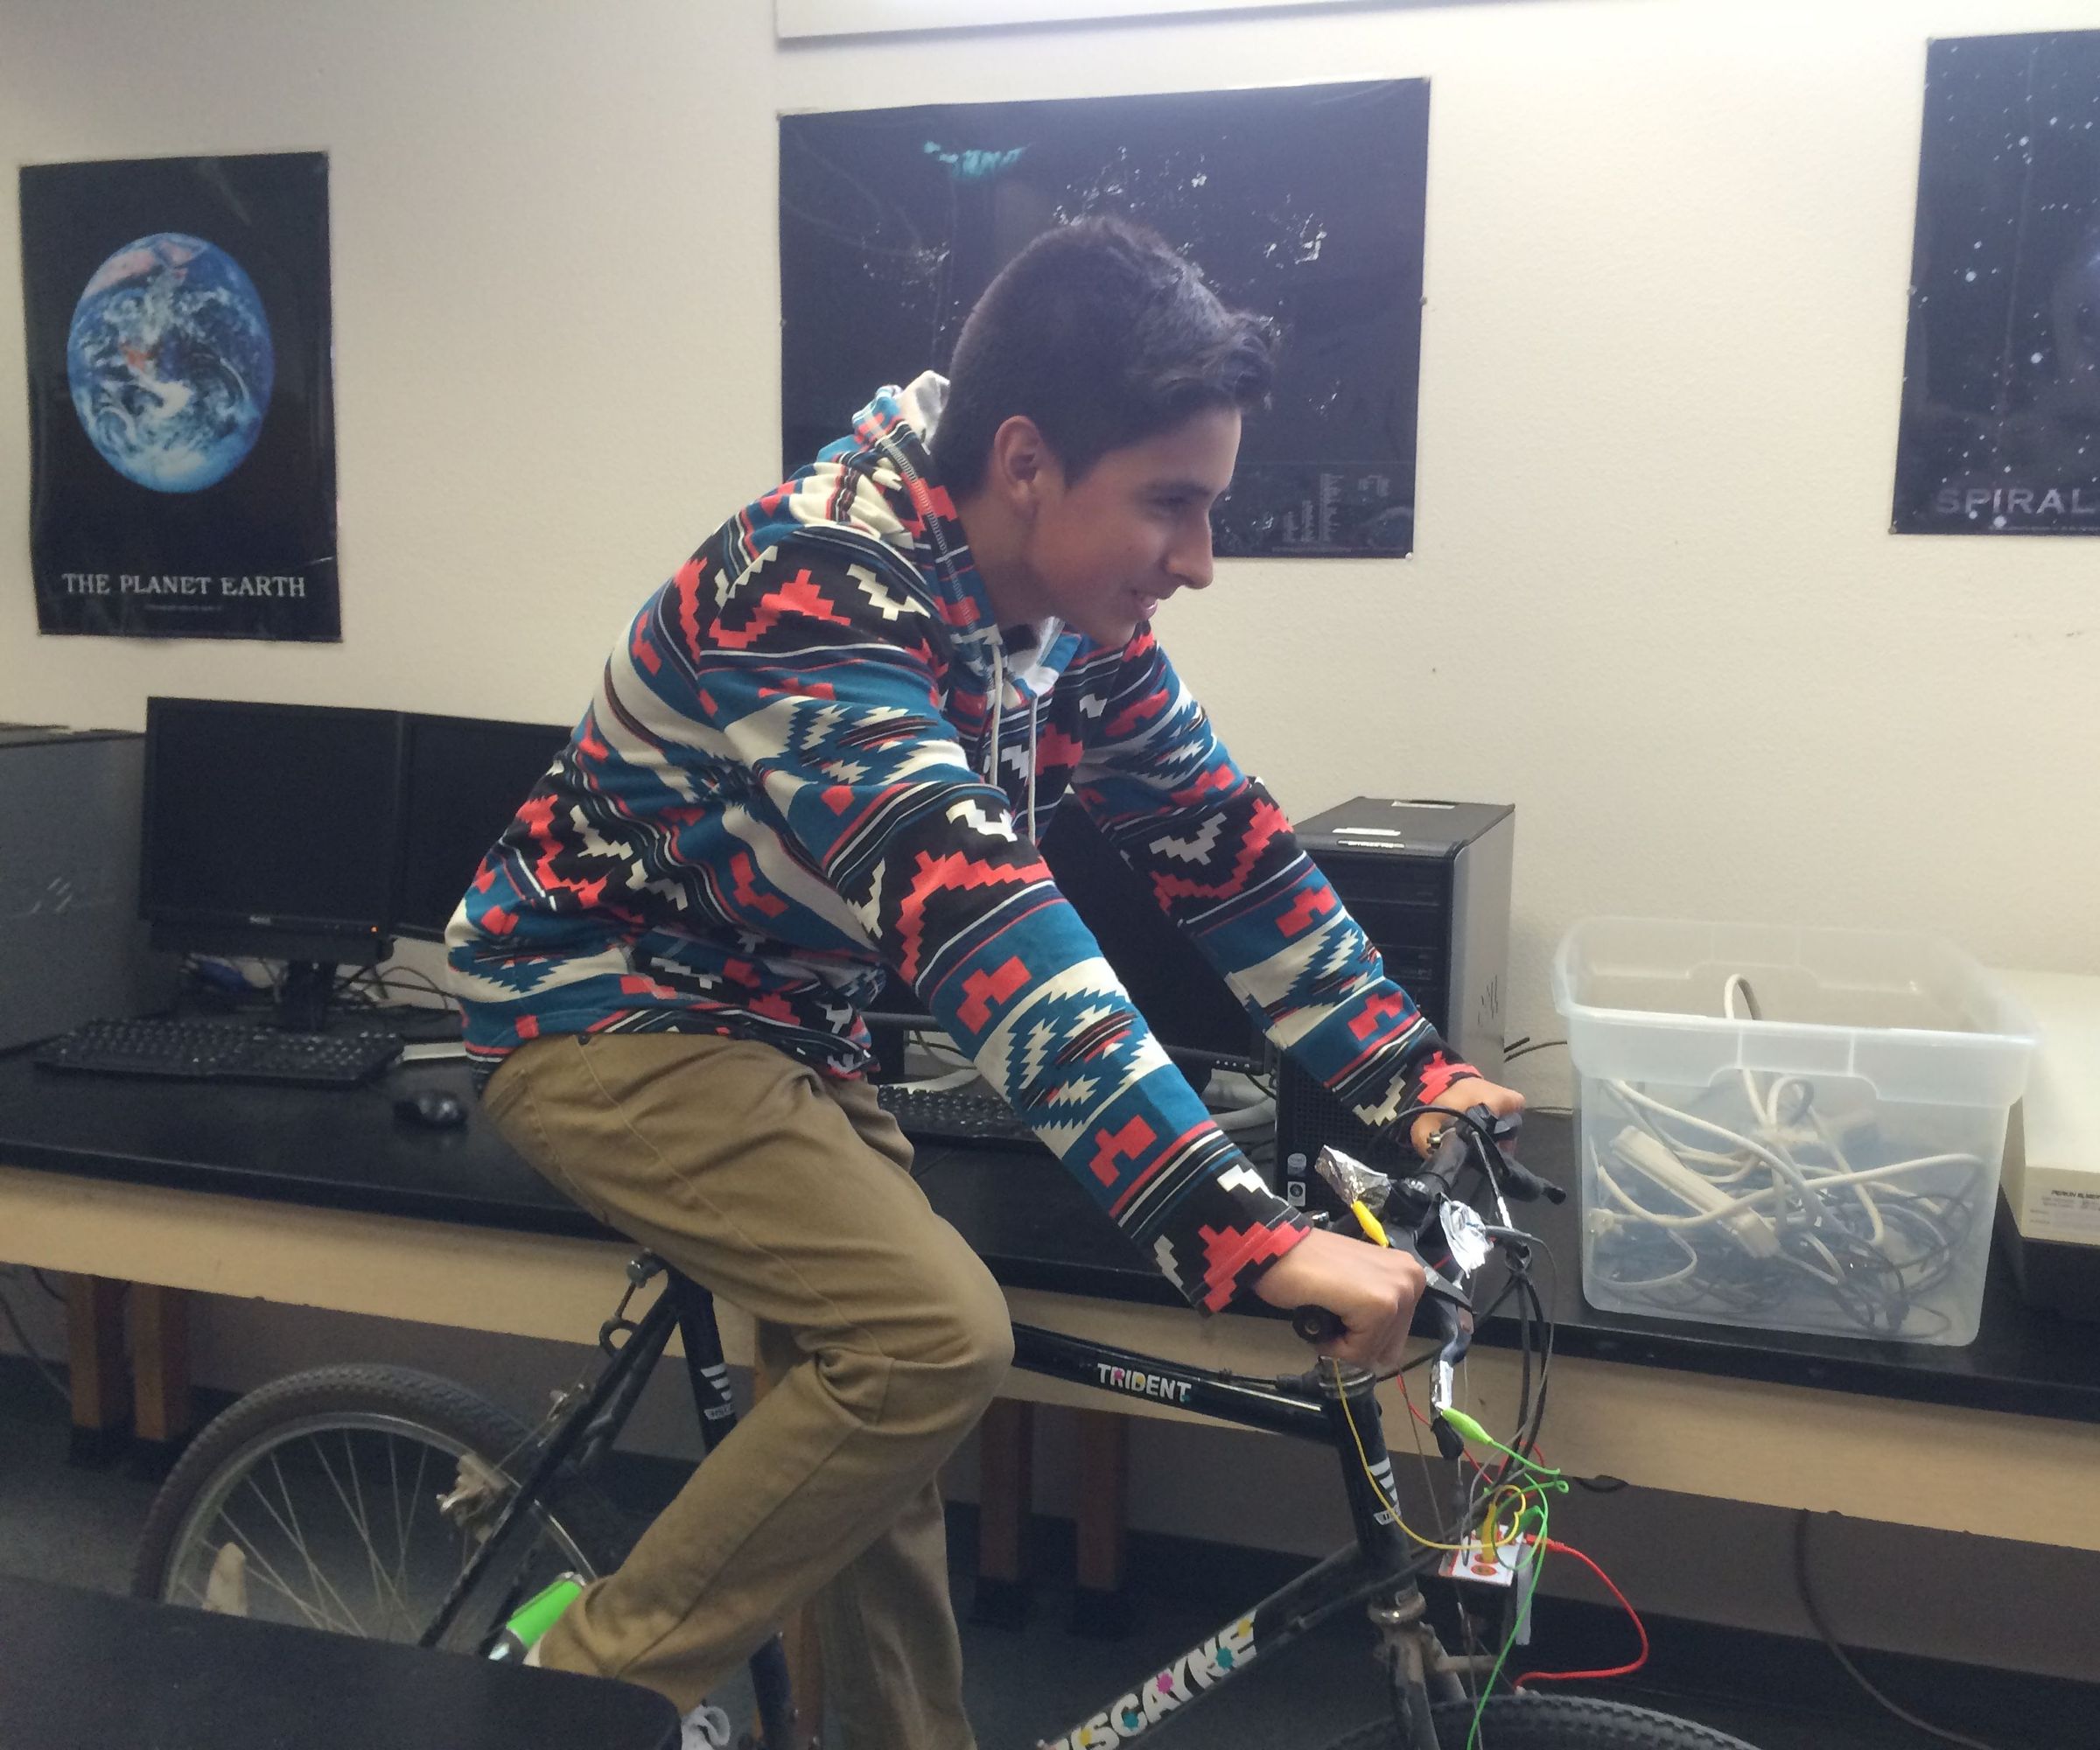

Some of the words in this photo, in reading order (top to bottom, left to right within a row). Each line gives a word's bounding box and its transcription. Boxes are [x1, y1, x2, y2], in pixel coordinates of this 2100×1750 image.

[1936, 488, 2096, 514] SPIRAL
[61, 573, 110, 595] THE
[120, 575, 212, 595] PLANET
[220, 576, 305, 597] EARTH
[1097, 1362, 1192, 1403] TRIDENT
